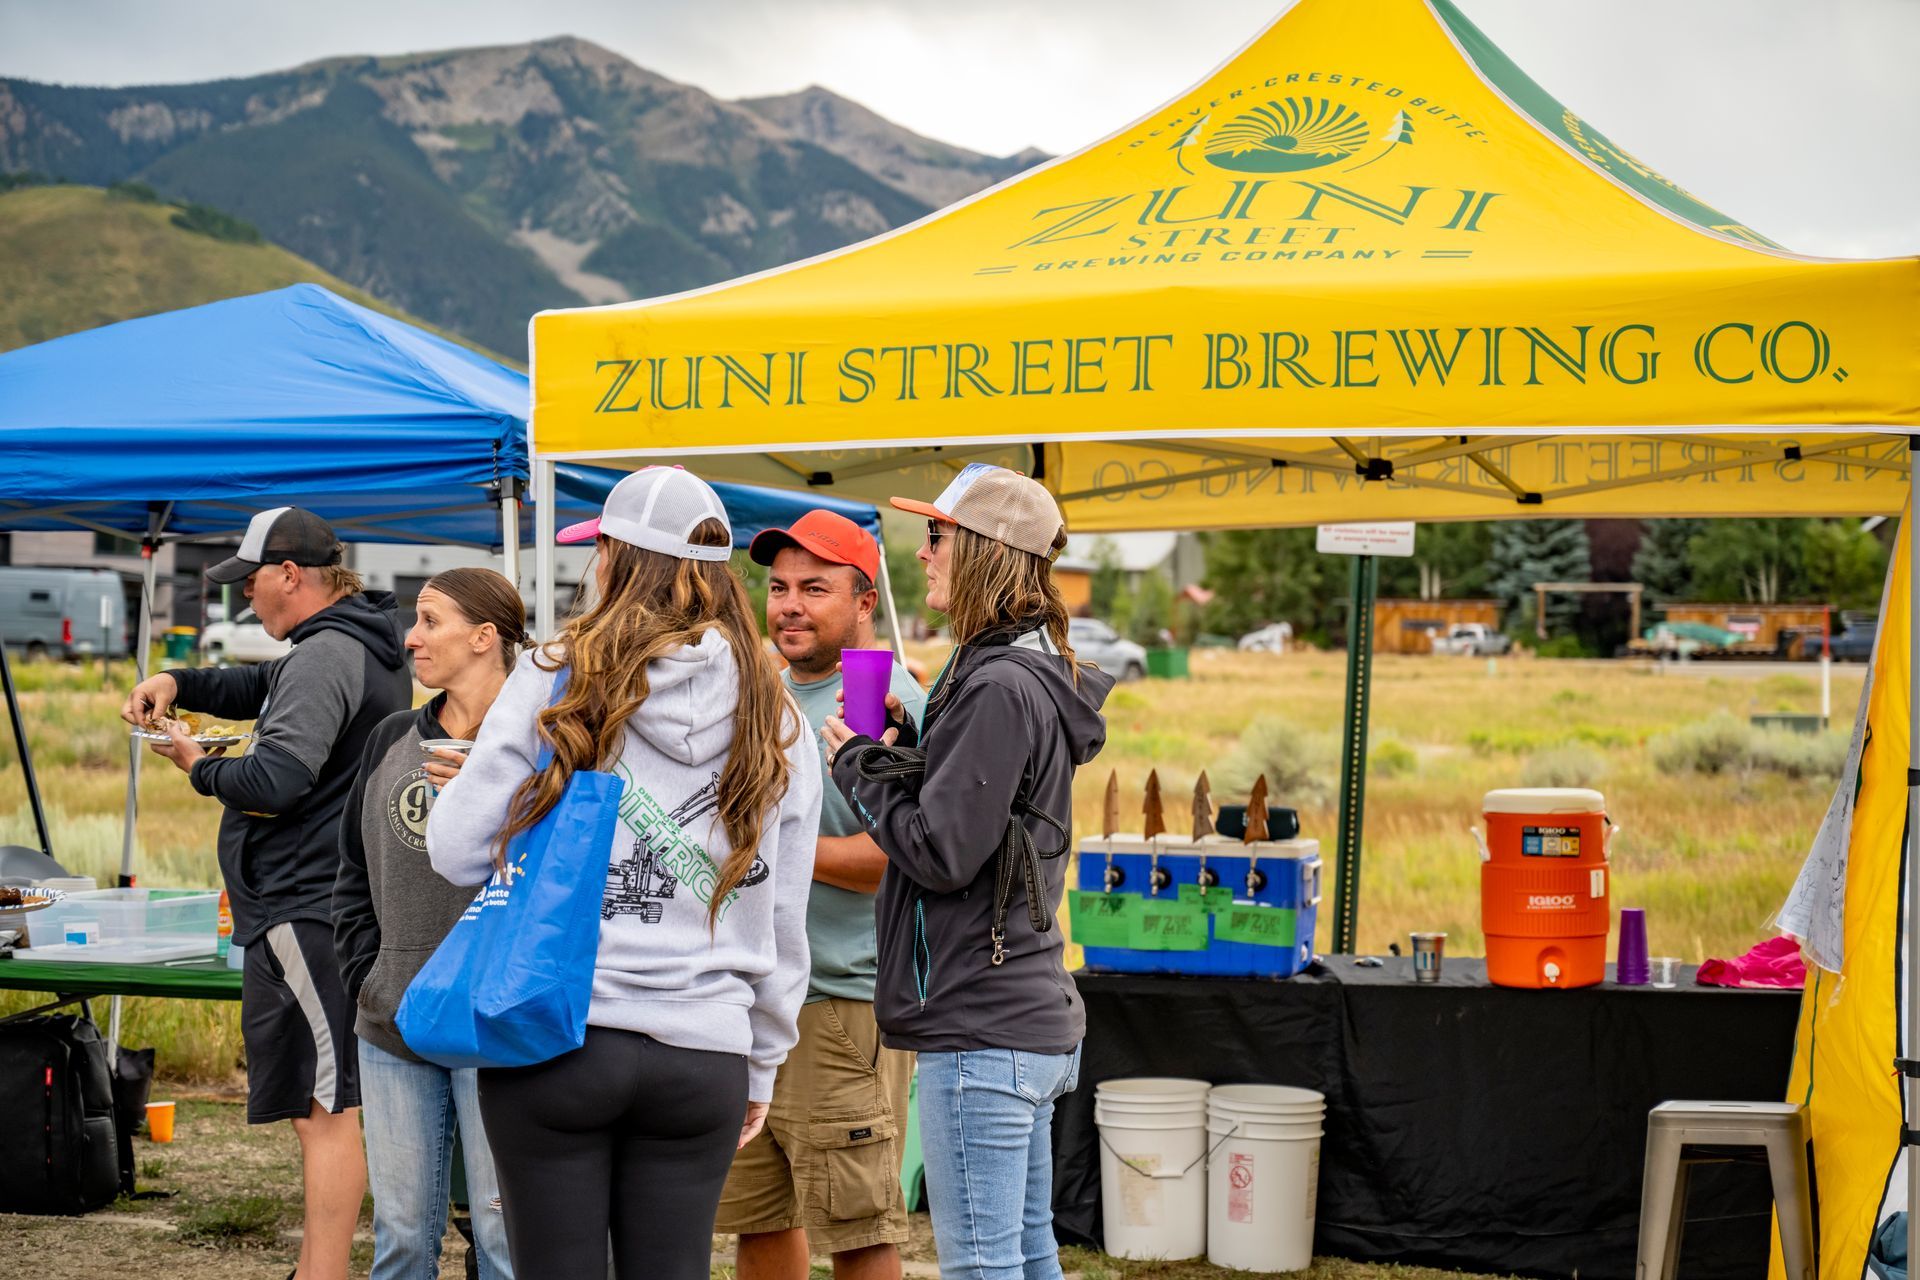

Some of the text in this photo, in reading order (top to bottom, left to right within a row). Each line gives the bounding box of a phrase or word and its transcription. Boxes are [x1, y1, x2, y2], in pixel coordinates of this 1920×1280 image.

[1264, 72, 1404, 98] CRESTED
[1408, 97, 1486, 138] BUTTE
[1005, 180, 1506, 249] ZUNI
[1120, 227, 1356, 251] STREET
[1032, 249, 1403, 272] BREWING COMPANY
[594, 321, 1849, 413] ZUNI STREET BREWING CO.
[390, 806, 427, 848] KING'S CRO
[638, 786, 684, 835] DIRTWORK
[692, 843, 741, 901] CONSTRUON
[1528, 894, 1574, 906] IGLOO
